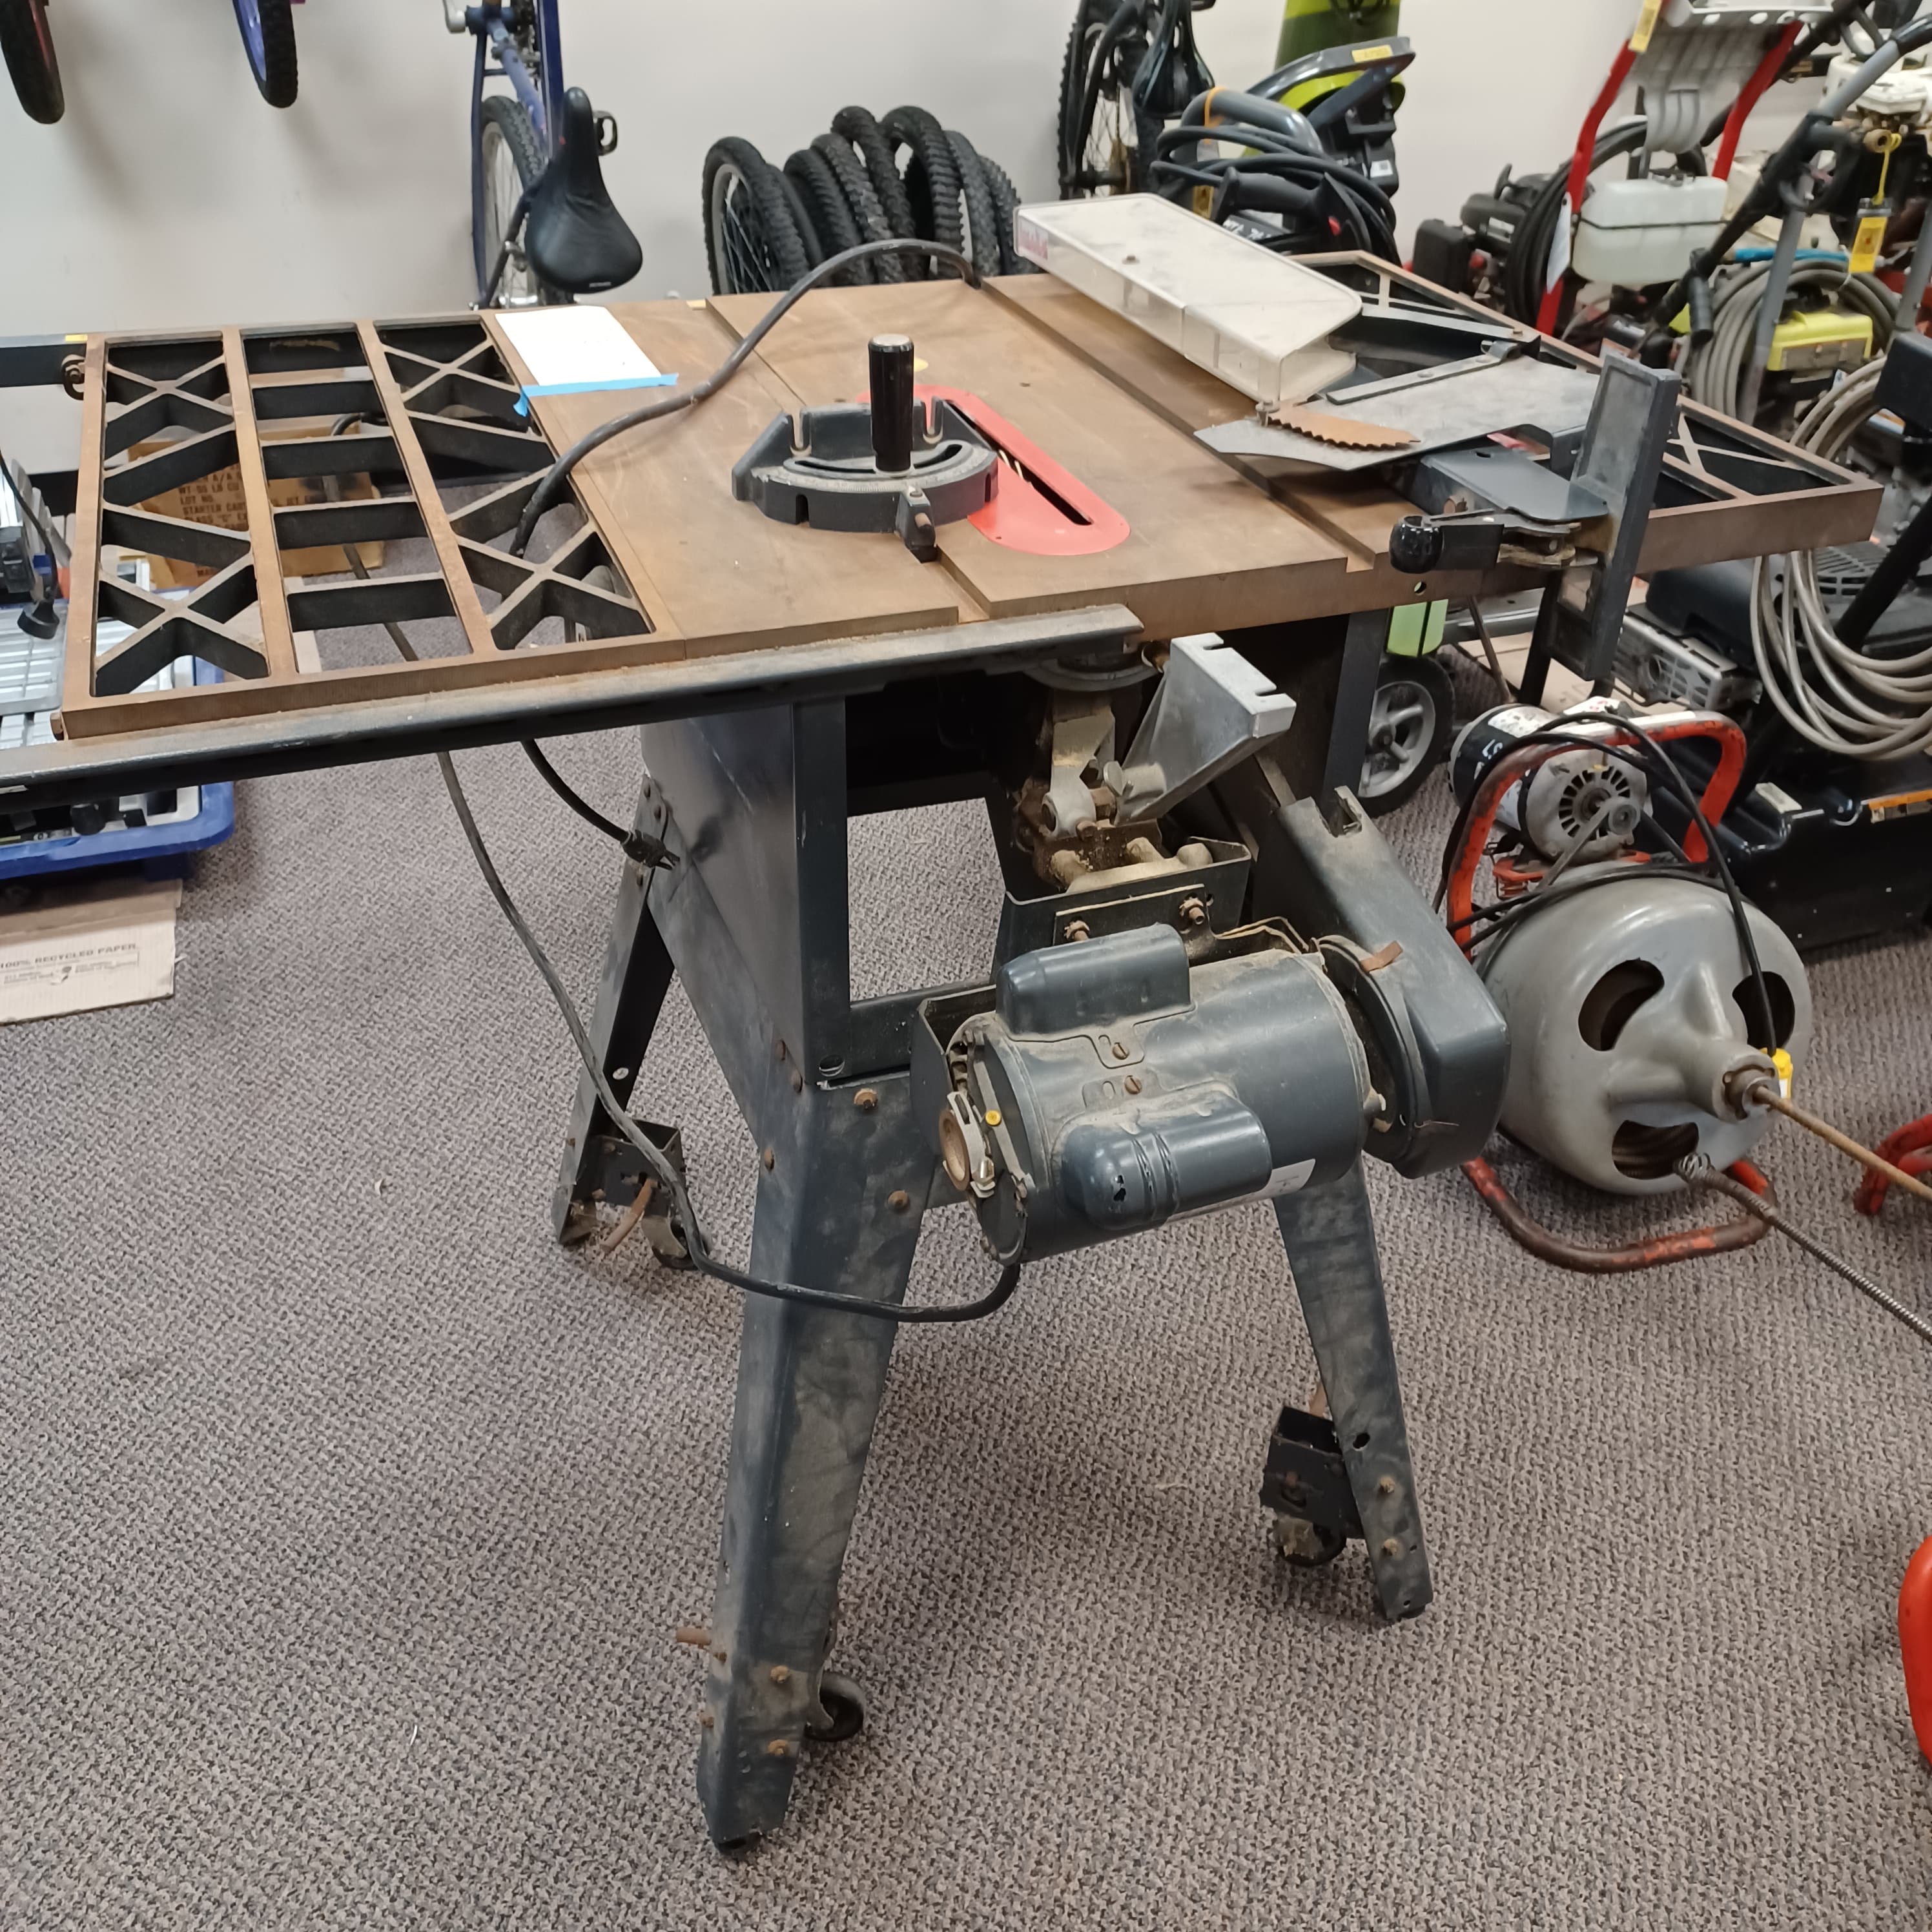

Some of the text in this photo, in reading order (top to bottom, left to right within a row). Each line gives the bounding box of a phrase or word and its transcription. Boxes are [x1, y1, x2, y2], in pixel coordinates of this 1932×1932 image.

[180, 495, 196, 505] LOT
[183, 504, 221, 515] STARTER
[34, 950, 94, 964] RECYCLED
[97, 943, 137, 954] PAPER
